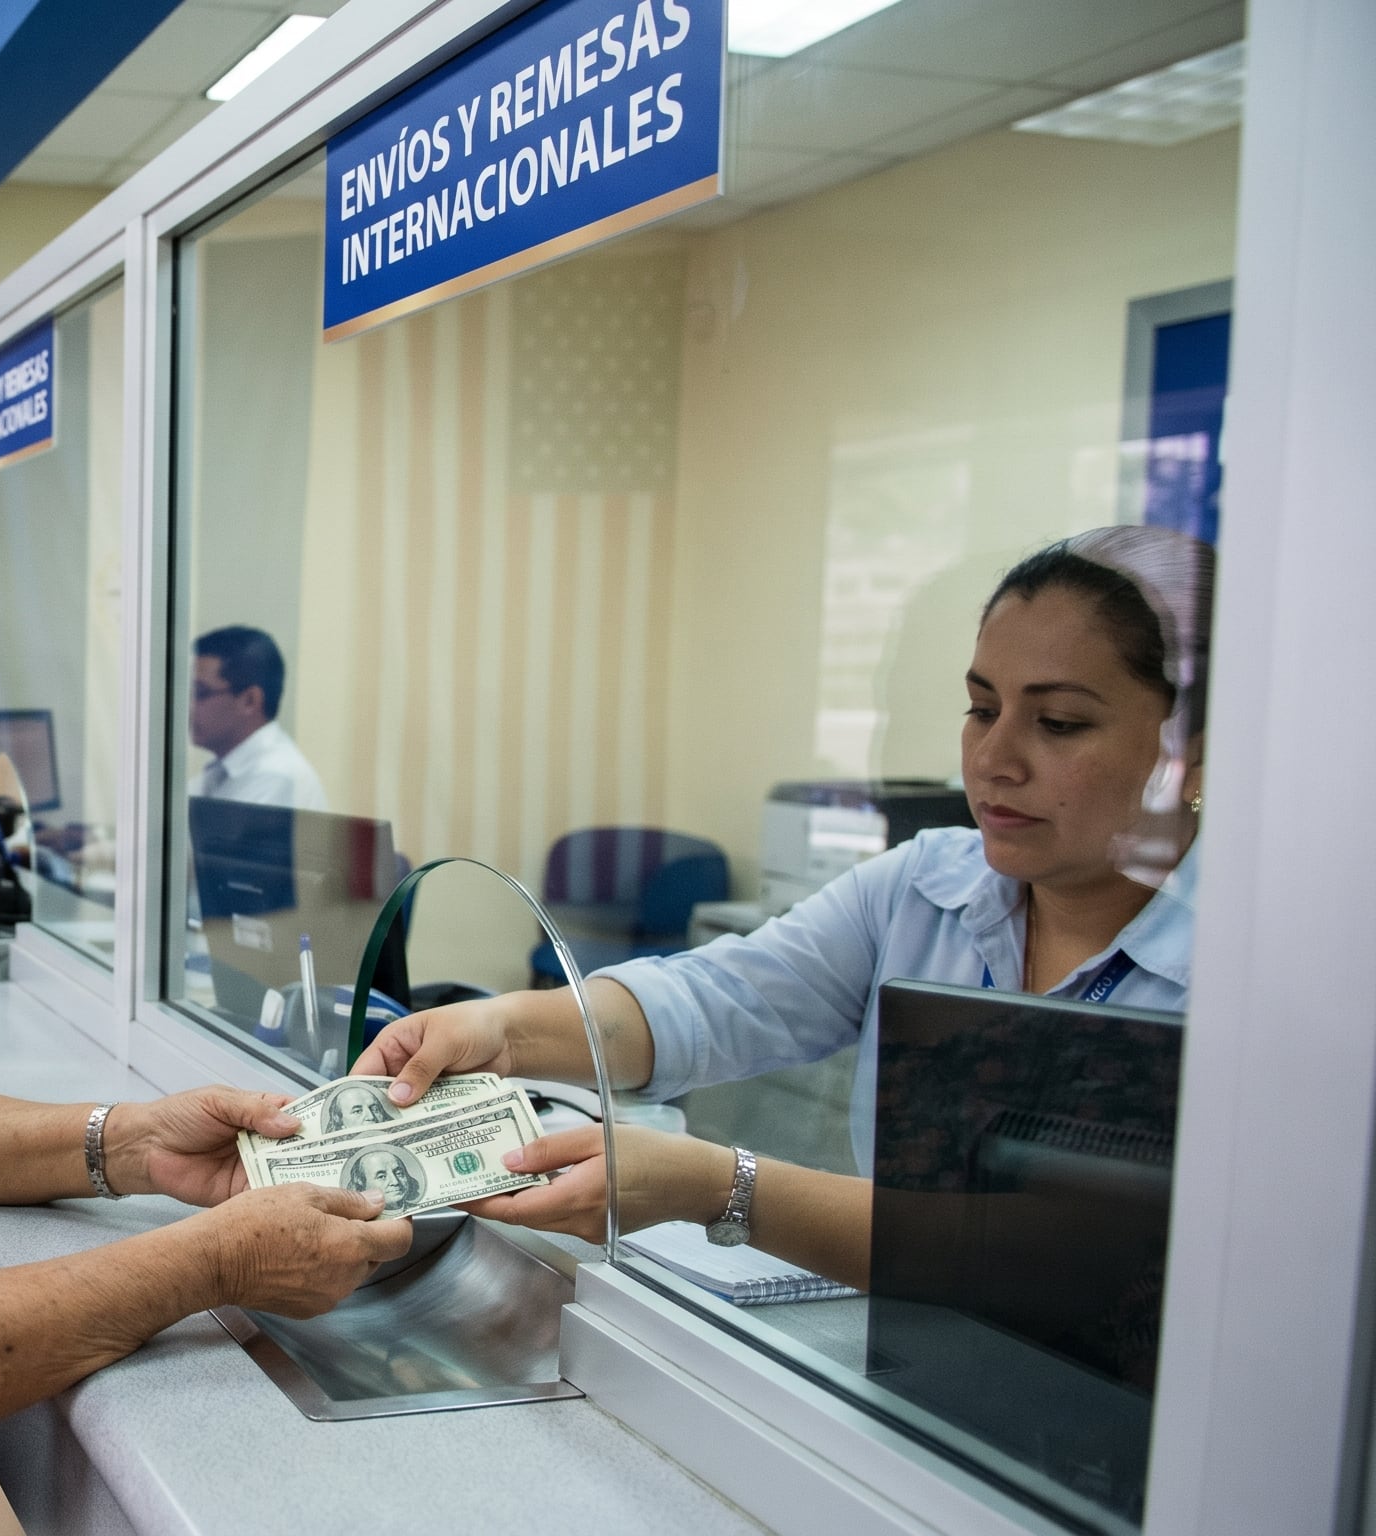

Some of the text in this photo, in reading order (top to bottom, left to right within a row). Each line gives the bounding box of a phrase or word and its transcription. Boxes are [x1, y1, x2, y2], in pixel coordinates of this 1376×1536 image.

[341, 0, 691, 221] ENVÍOS Y REMESAS
[342, 73, 684, 285] INTERNACIONALES
